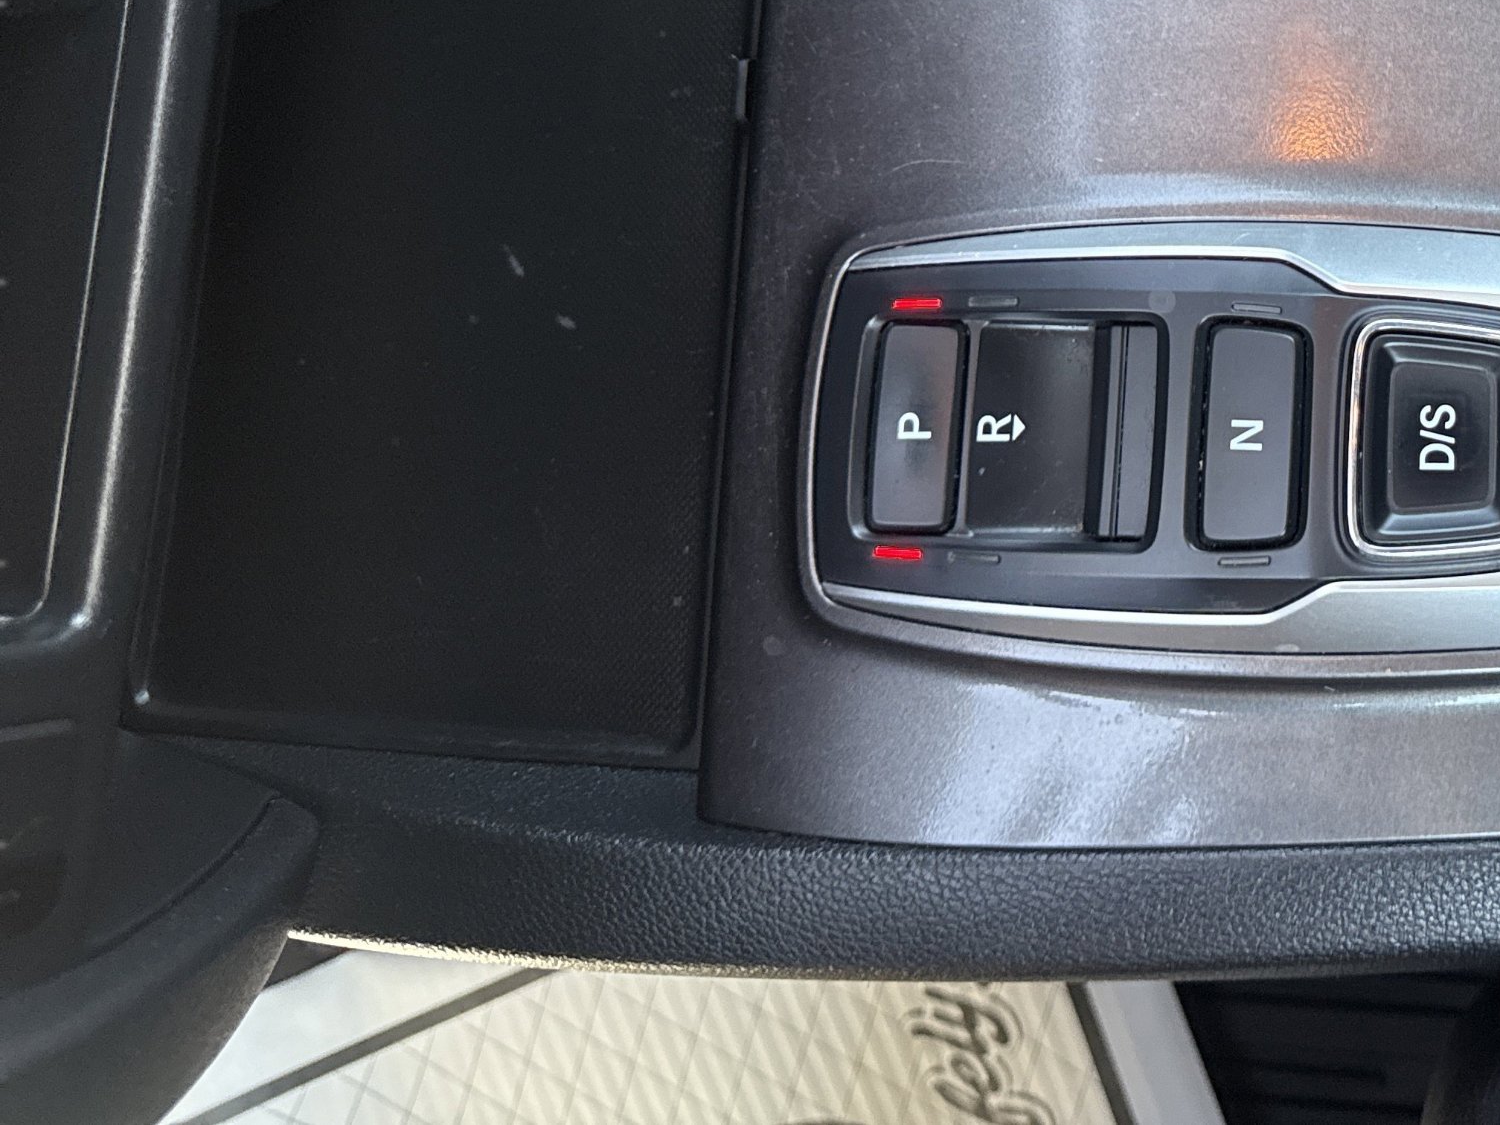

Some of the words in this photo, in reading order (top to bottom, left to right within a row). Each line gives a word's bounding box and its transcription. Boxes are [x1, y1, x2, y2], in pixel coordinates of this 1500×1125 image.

[897, 411, 932, 441] P
[976, 413, 1012, 442] R
[1230, 419, 1264, 452] N
[1419, 404, 1456, 471] D/S
